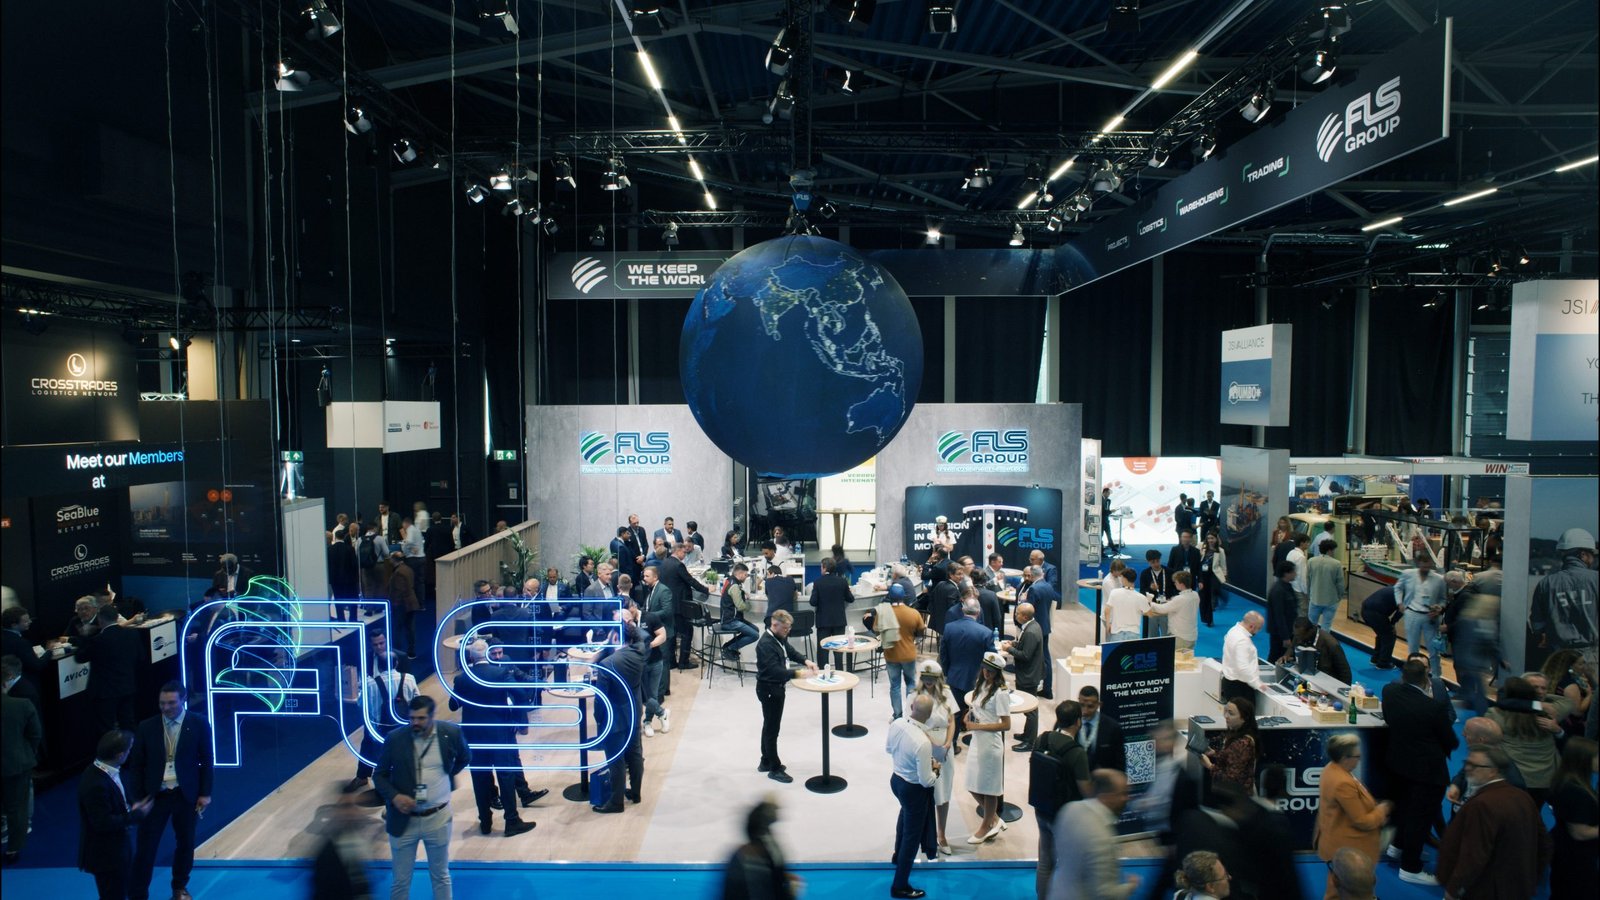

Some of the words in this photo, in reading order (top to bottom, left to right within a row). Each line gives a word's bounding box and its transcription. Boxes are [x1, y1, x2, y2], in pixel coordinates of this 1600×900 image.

[1345, 75, 1401, 137] FLS
[1345, 115, 1400, 153] GROUP
[1247, 156, 1284, 183] TRADING
[1179, 187, 1224, 216] WAREHOUSING
[1139, 217, 1164, 236] LOGISTICS
[628, 264, 653, 274] WE
[657, 264, 698, 274] KEEP
[628, 275, 659, 285] THE
[31, 378, 118, 391] CROSSTRADES
[614, 431, 670, 454] FLS
[972, 430, 1028, 453] FLS
[66, 453, 103, 470] Meet
[104, 453, 128, 467] our
[129, 450, 184, 465] Members
[615, 455, 670, 465] GROUP
[972, 454, 1028, 463] GROUP
[92, 474, 106, 489] at
[56, 506, 100, 522] SeaBlue
[914, 533, 924, 541] IN
[1018, 527, 1054, 543] FLS
[1018, 542, 1054, 550] GROUP
[50, 556, 110, 577] CROSSTRADES
[181, 597, 636, 770] FLS
[1106, 681, 1133, 691] READY
[1146, 677, 1170, 686] MOVE
[1113, 690, 1129, 698] THE
[1130, 686, 1163, 696] WORLD?
